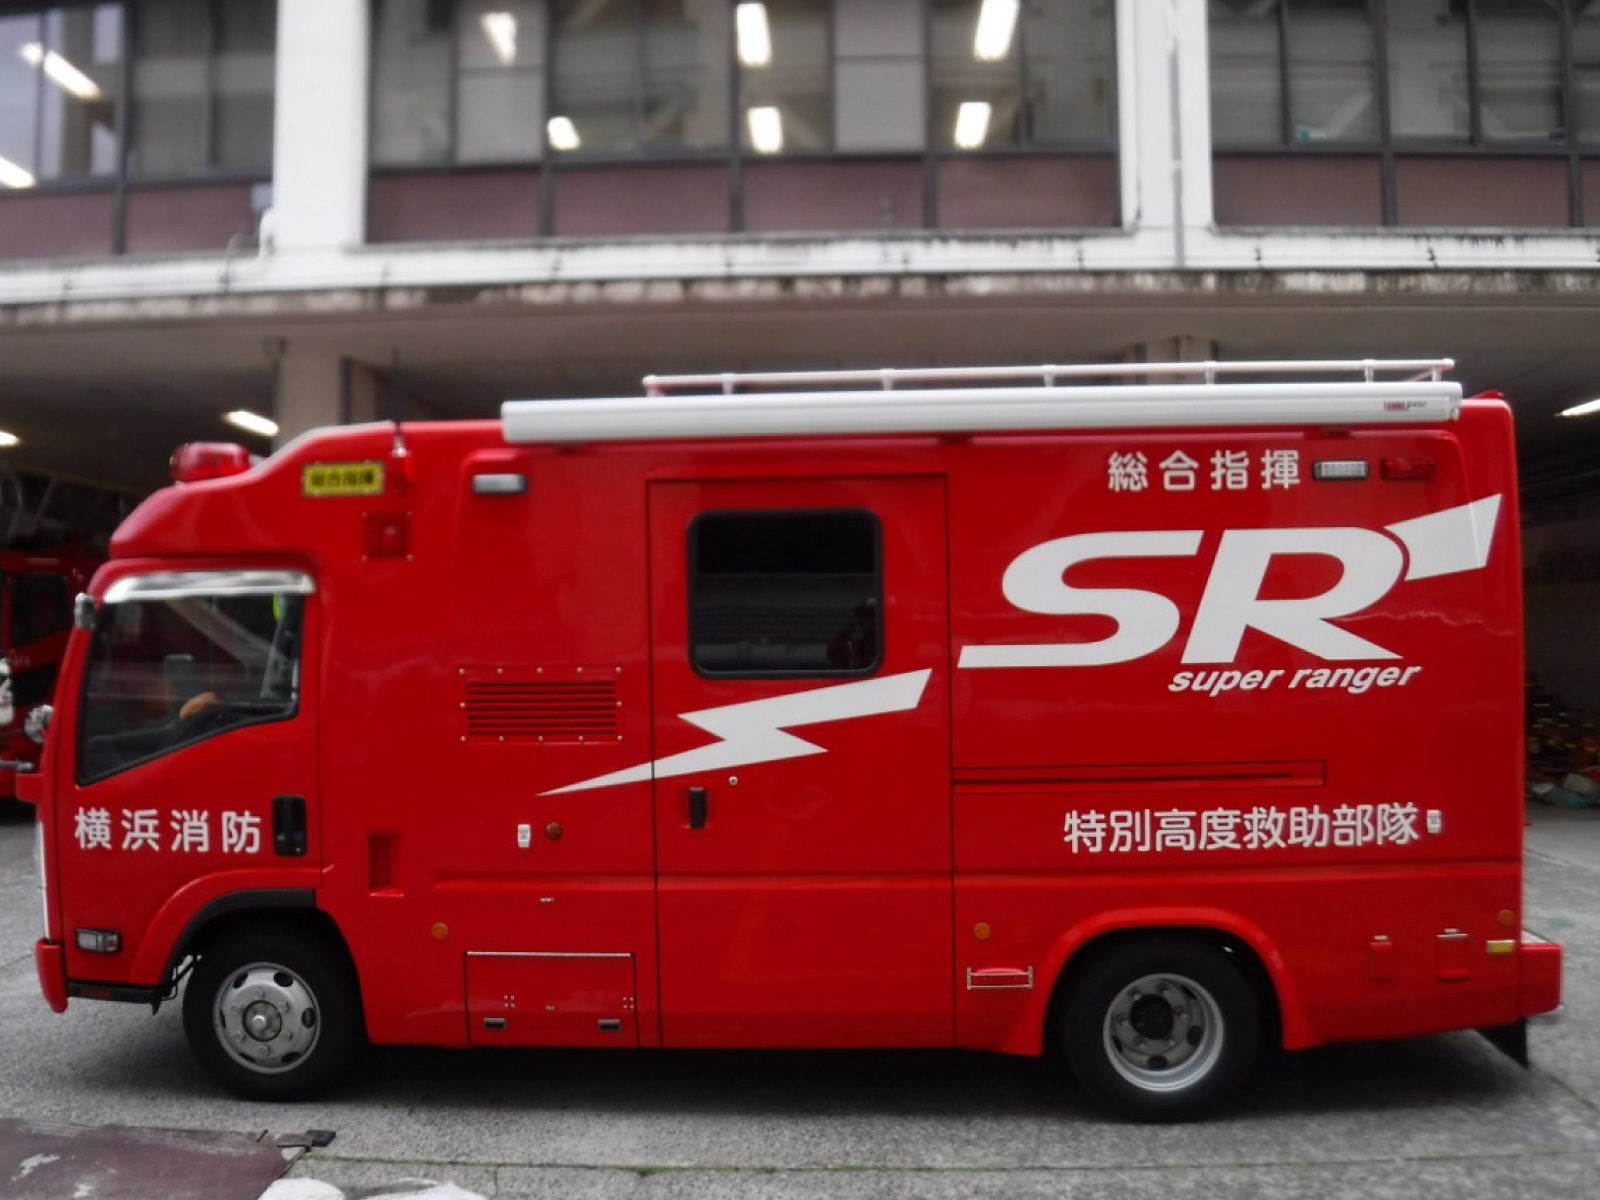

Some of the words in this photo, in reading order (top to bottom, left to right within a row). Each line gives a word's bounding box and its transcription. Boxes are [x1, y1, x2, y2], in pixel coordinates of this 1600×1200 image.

[1108, 448, 1301, 493] 総合指揮
[957, 526, 1405, 669] SR
[1167, 668, 1285, 698] super
[1287, 665, 1422, 695] ranger
[74, 806, 261, 855] 横浜消防
[1063, 801, 1420, 854] 特別高度救助部隊
